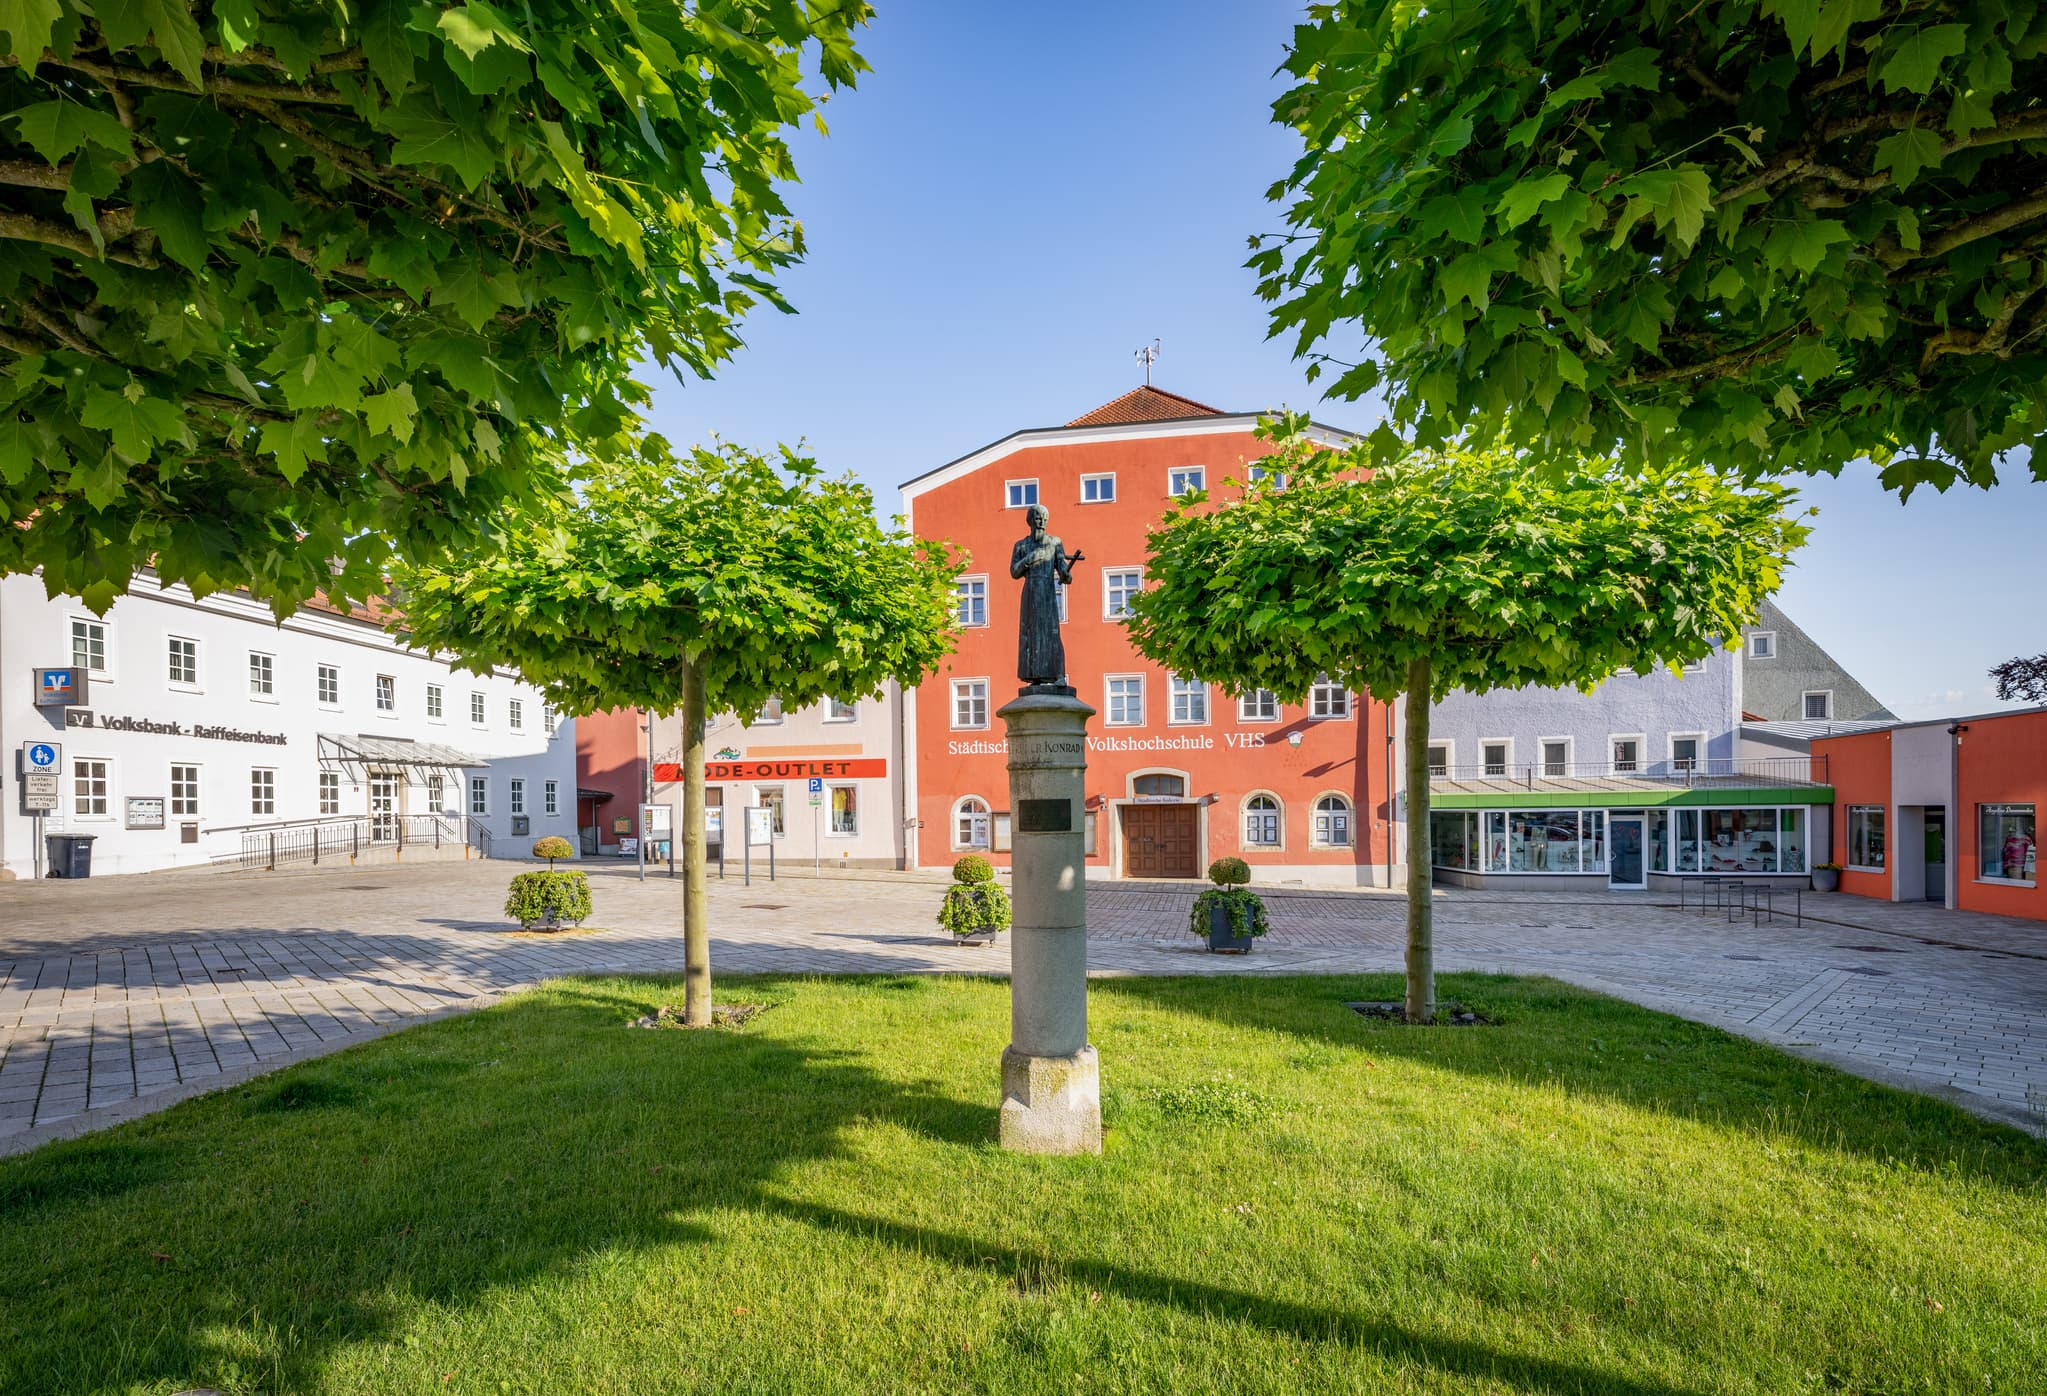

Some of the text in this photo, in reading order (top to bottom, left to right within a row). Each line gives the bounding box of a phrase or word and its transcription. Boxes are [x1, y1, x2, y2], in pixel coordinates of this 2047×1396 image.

[100, 714, 181, 736] Volksbank
[193, 724, 288, 746] Raiffeisenbank
[948, 732, 1265, 755] Städtisch Volkshochschule VHS
